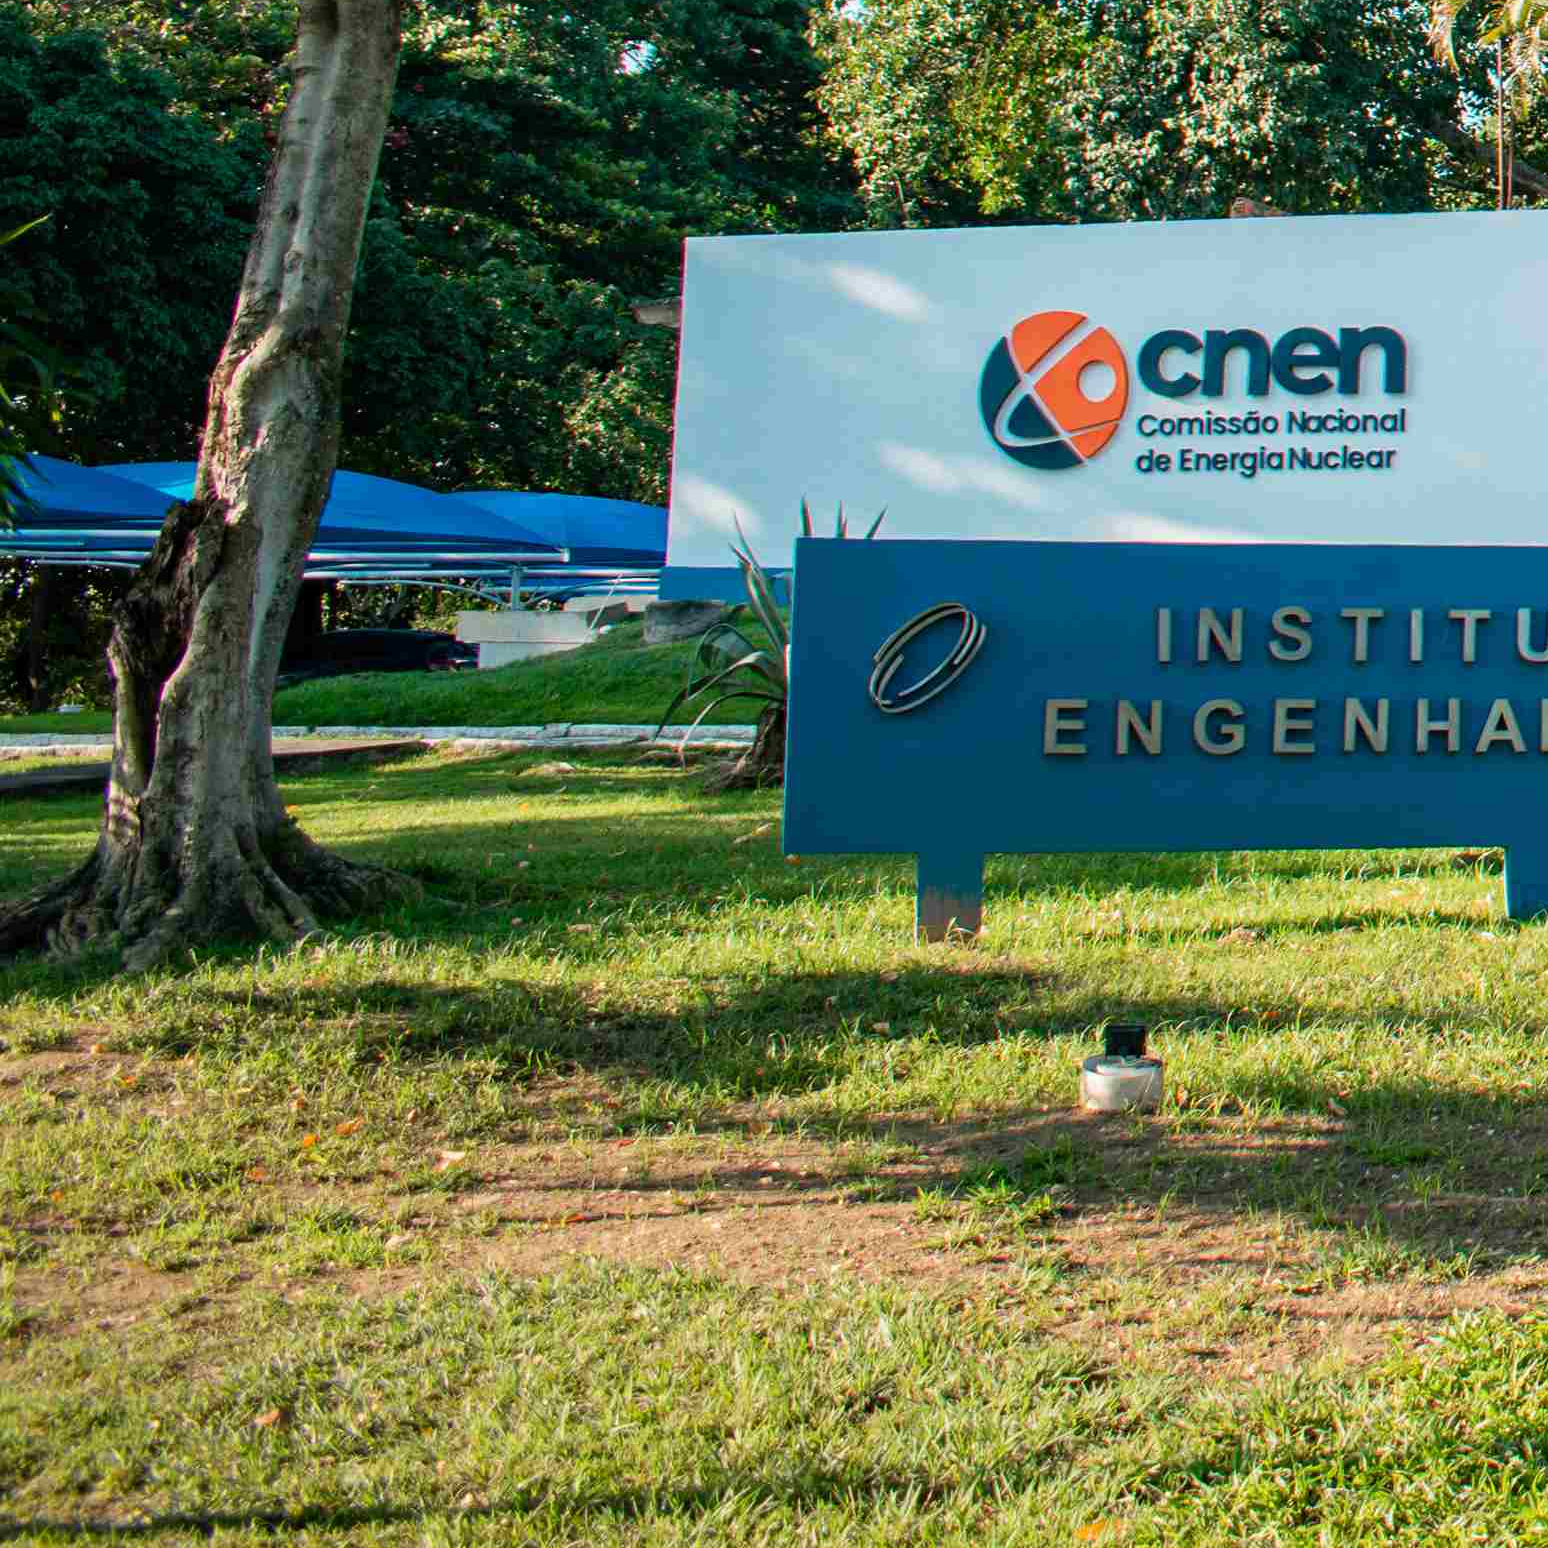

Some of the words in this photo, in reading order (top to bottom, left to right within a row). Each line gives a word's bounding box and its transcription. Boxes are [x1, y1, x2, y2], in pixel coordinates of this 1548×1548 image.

[1137, 325, 1406, 399] cnen
[1137, 409, 1279, 438] Comissão
[1286, 408, 1406, 435] Nacional
[1135, 448, 1171, 473] de
[1178, 445, 1284, 479] Energia
[1287, 444, 1397, 471] Nuclear
